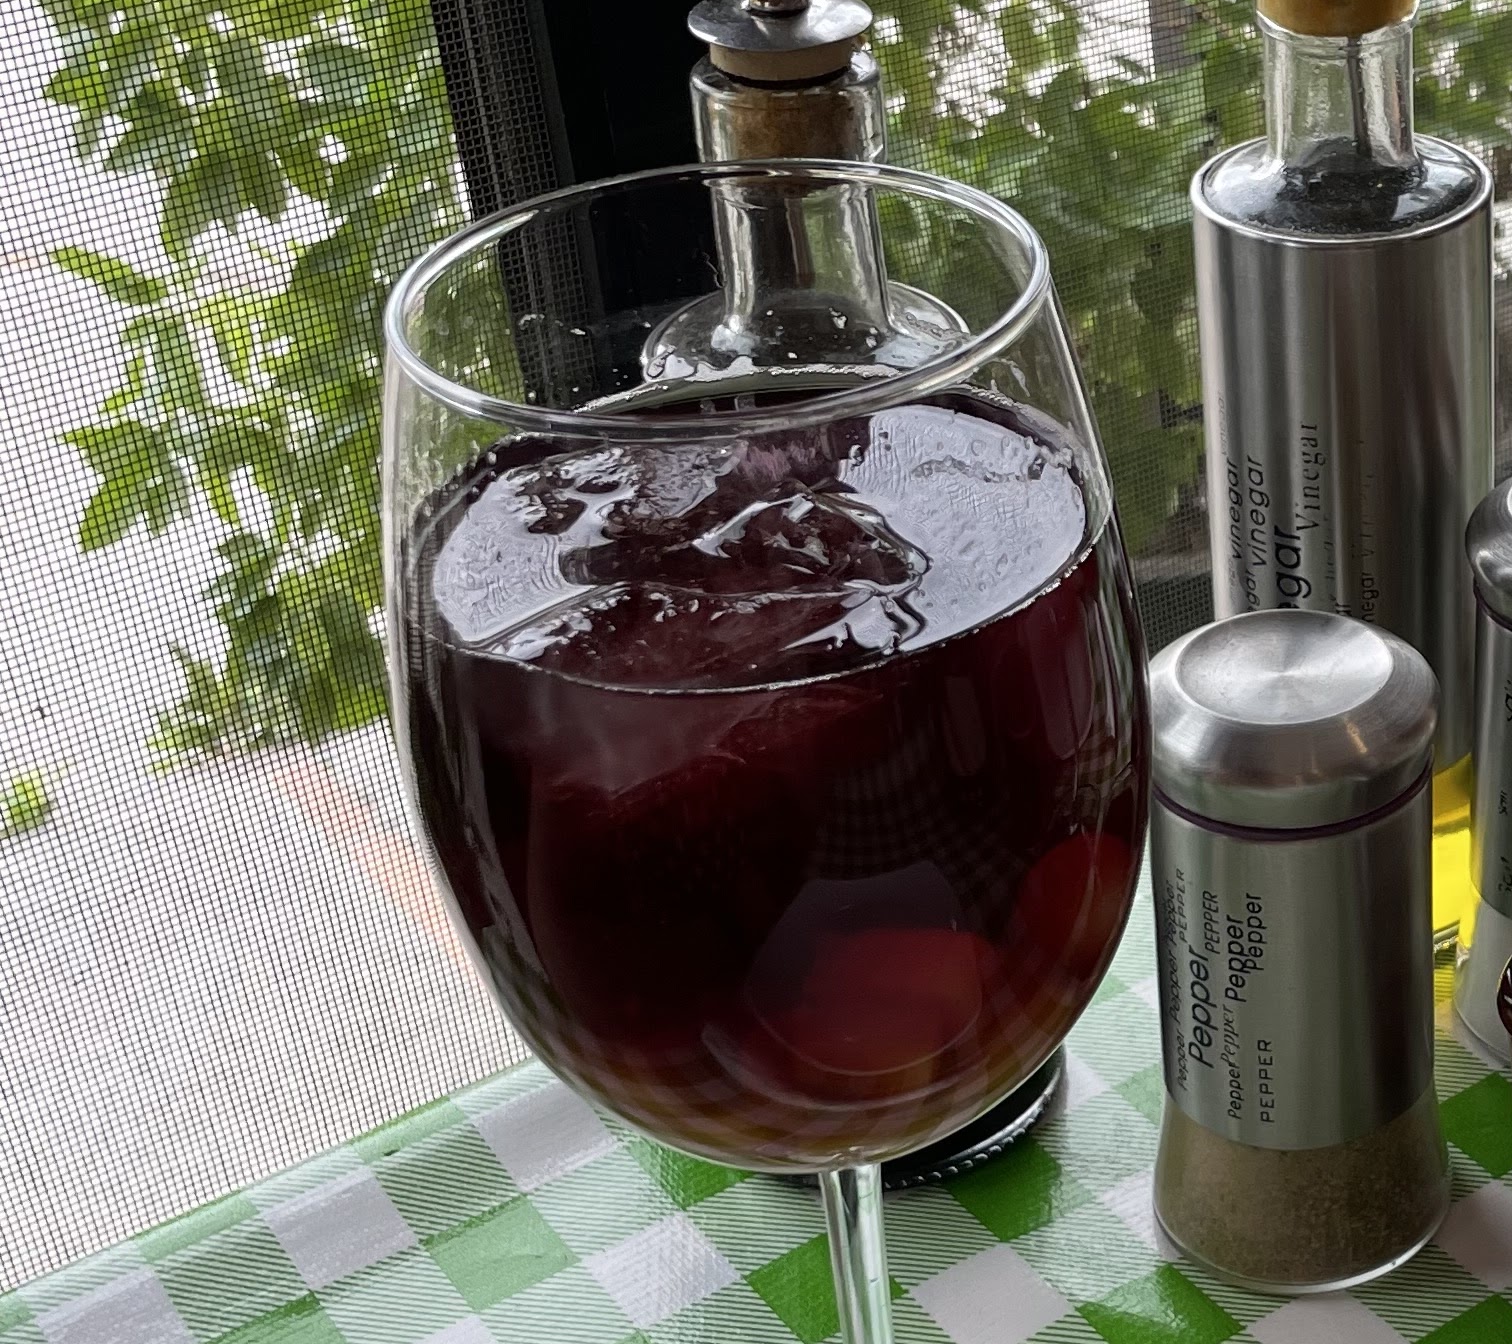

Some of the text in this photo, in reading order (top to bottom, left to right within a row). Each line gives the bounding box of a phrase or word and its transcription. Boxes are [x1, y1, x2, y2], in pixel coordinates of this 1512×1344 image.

[1226, 457, 1243, 560] vinegar
[1246, 454, 1270, 567] vinegar
[1295, 423, 1325, 531] Vinegar
[1175, 868, 1188, 944] PEPPER
[1202, 890, 1220, 955] PEPPER
[1243, 892, 1267, 971] Pepper
[1168, 949, 1182, 1024] Pepper
[1225, 913, 1251, 1003] Pepper
[1188, 944, 1218, 1069] Pepper
[1220, 1003, 1240, 1067] Pepper
[1176, 1027, 1189, 1091] Pepper
[1227, 1061, 1244, 1120] Pepper
[1257, 1039, 1275, 1123] PEPPER
